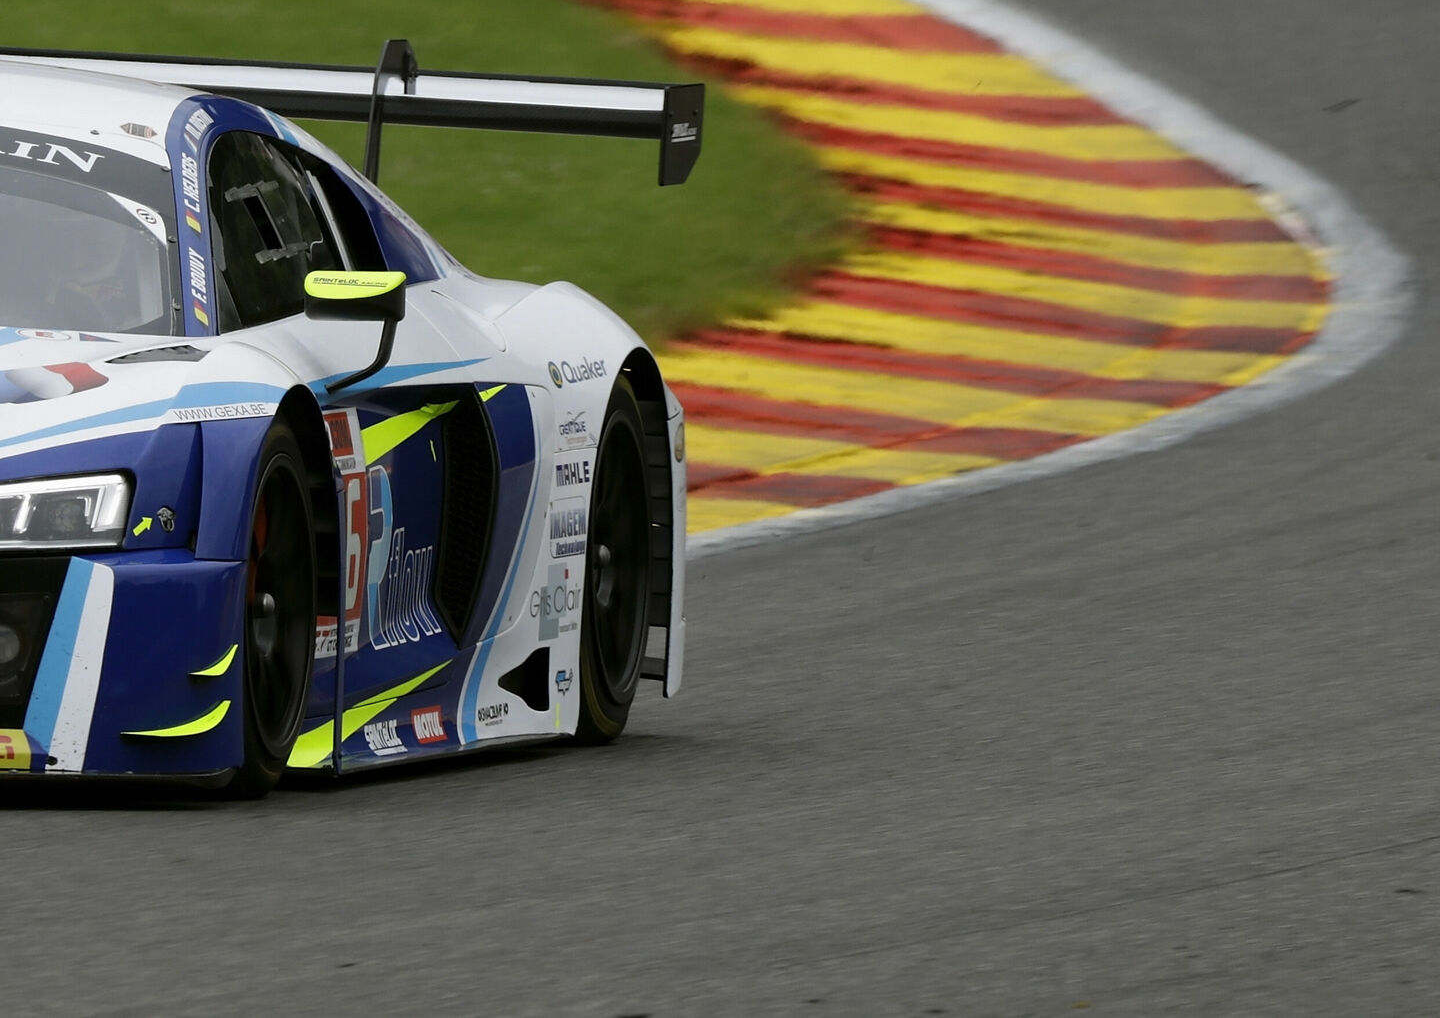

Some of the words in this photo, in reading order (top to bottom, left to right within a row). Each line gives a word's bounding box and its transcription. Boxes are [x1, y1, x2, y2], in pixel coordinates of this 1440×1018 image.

[560, 356, 608, 384] Quaker
[174, 402, 270, 422] WWW.GEXA.BE
[555, 460, 590, 487] MAHLE
[553, 583, 582, 614] Clair
[413, 711, 445, 740] MOTUL
